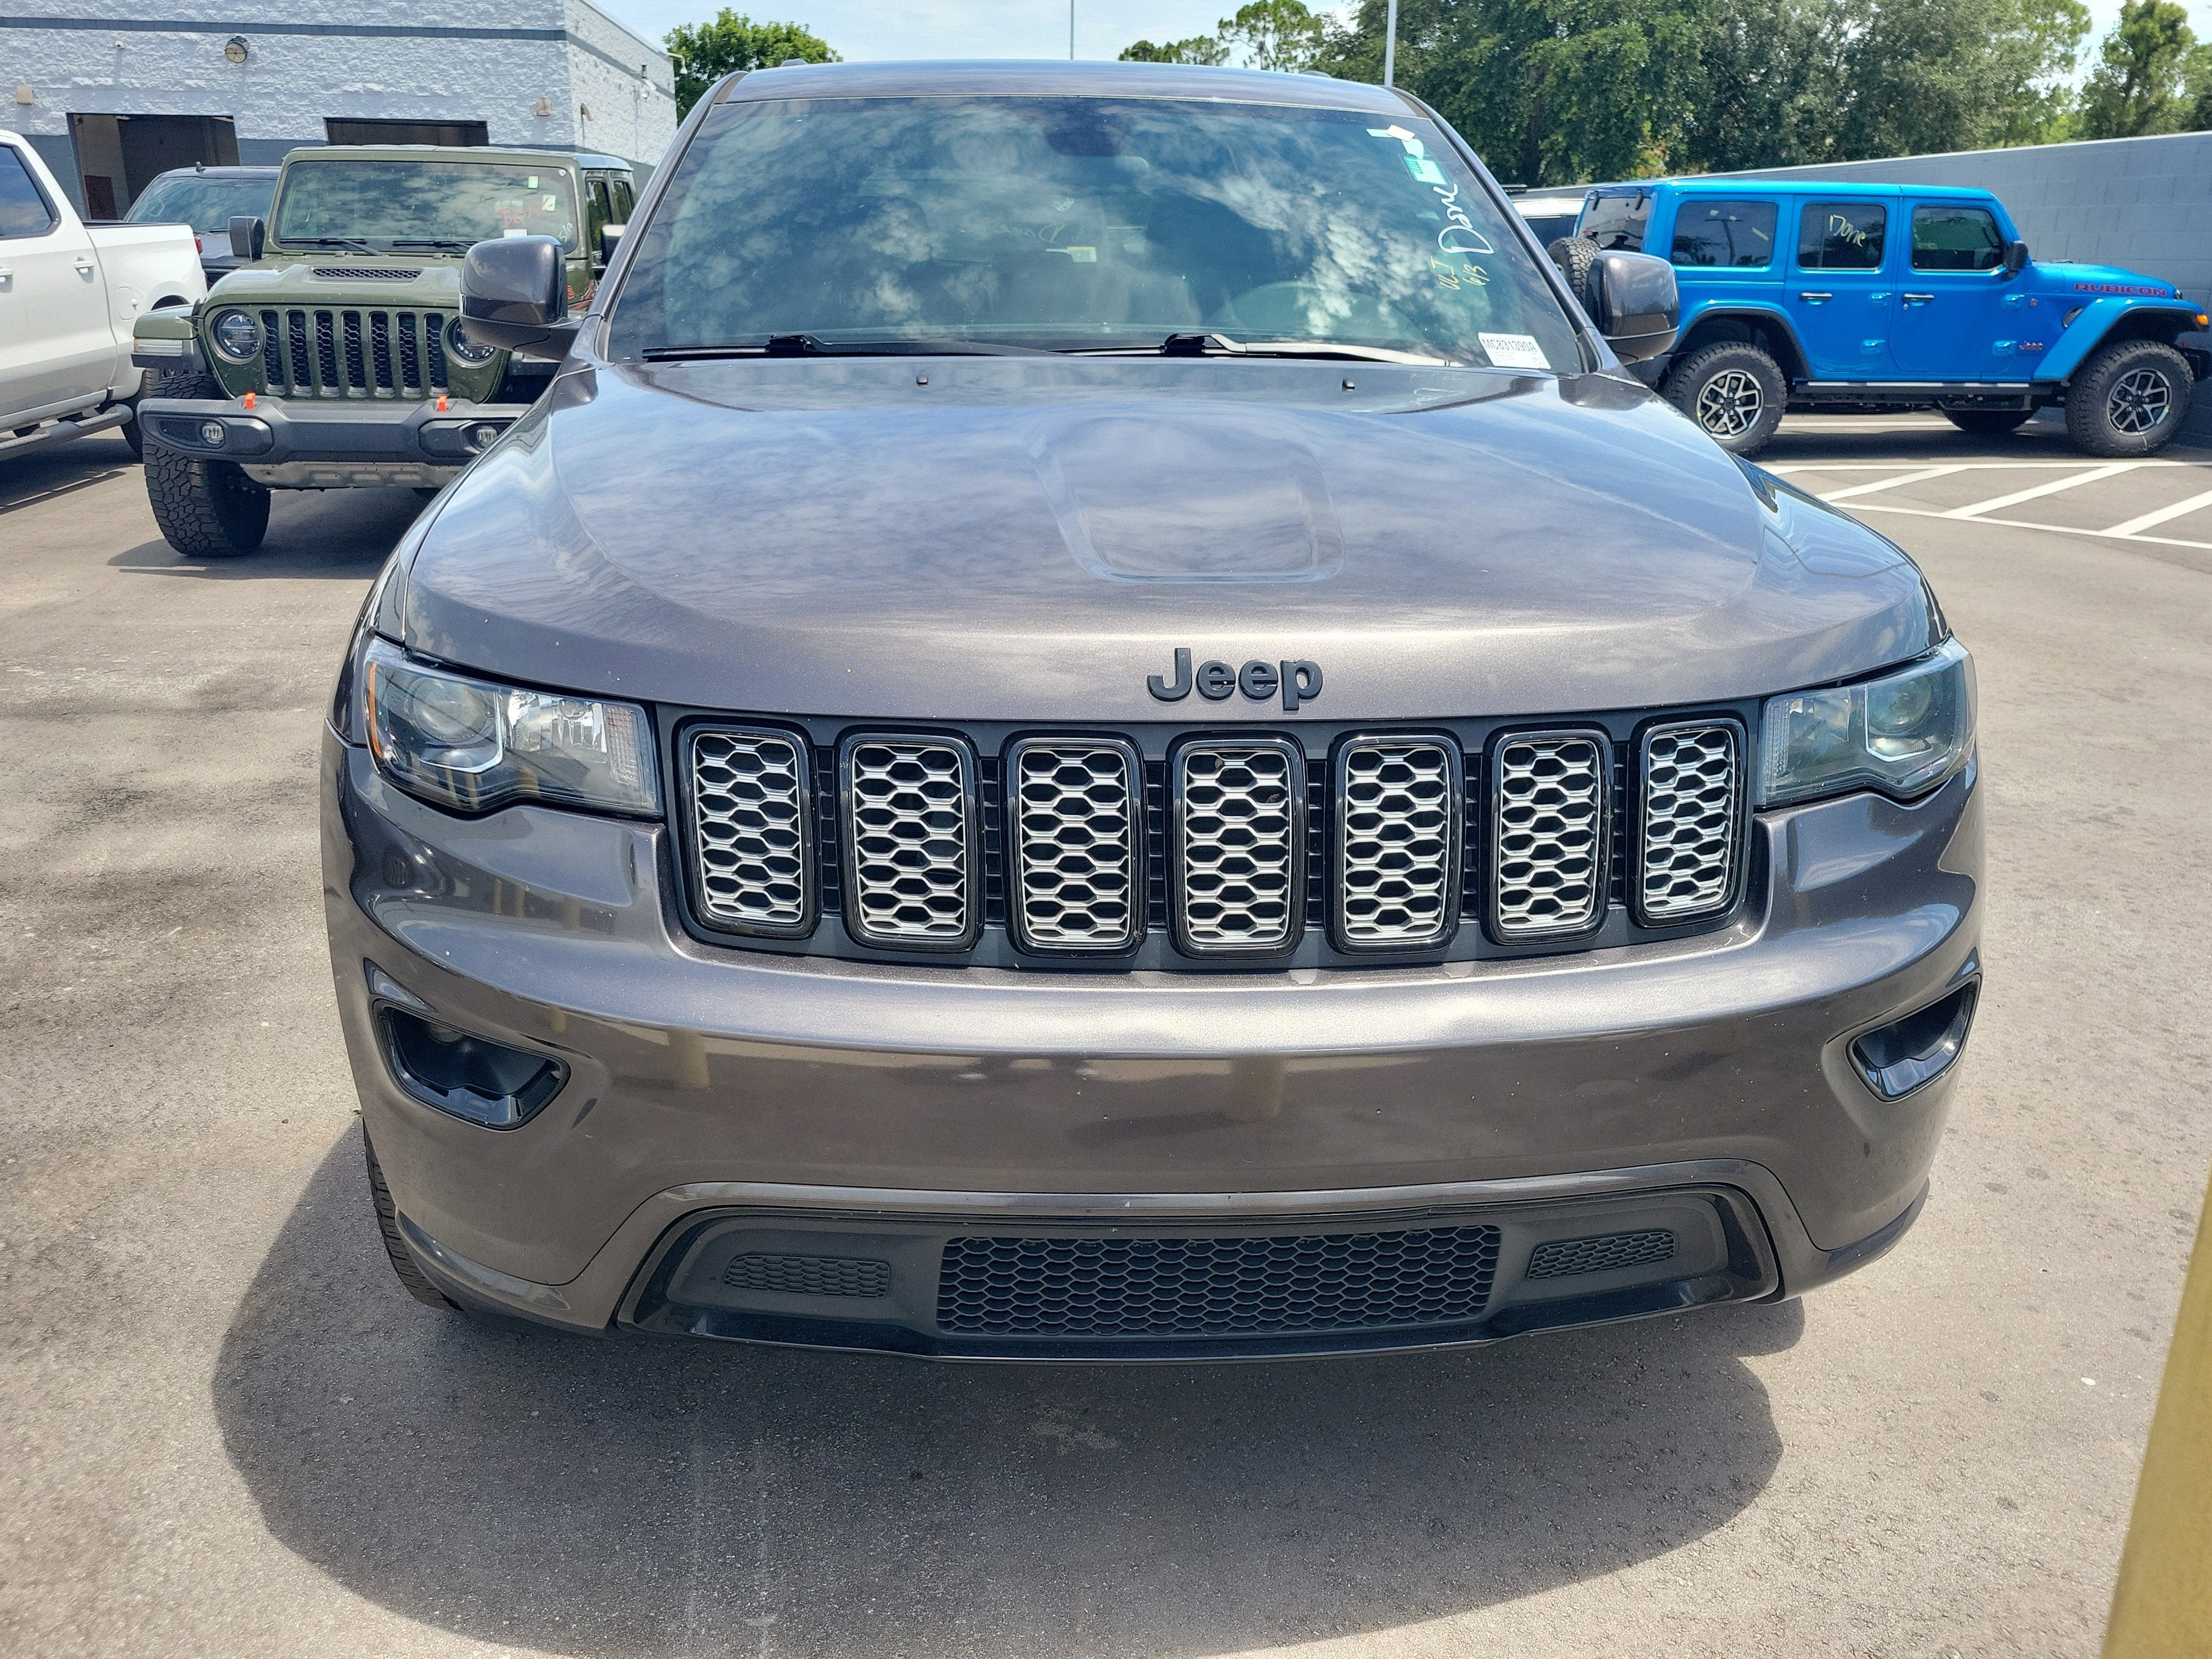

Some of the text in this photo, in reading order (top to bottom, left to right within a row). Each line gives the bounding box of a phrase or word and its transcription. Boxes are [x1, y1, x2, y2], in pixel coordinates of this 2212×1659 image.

[1433, 183, 1494, 254] Done
[1829, 214, 1866, 247] Done
[2074, 283, 2167, 297] RUBICON
[1481, 338, 1537, 352] MC831390A
[1147, 647, 1323, 710] Jeep
